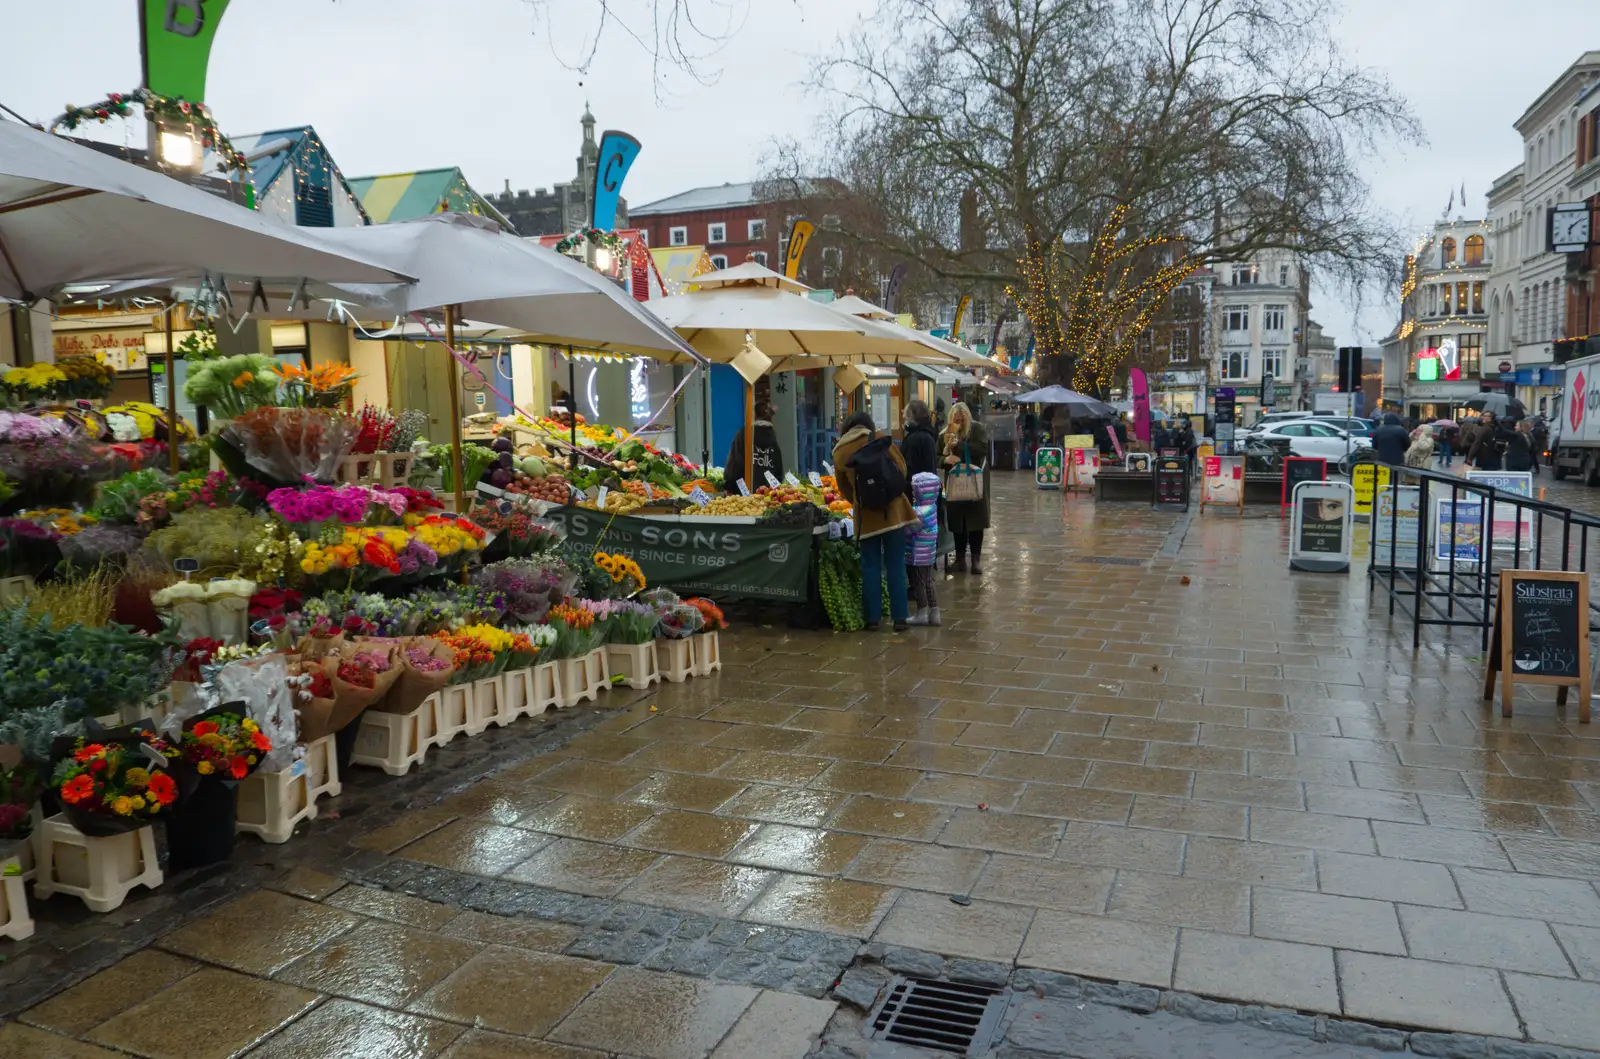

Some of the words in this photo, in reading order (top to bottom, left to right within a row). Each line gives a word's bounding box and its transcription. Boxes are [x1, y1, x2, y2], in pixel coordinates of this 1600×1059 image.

[603, 152, 624, 193] C
[596, 528, 633, 542] AND
[641, 526, 742, 552] SONS
[639, 549, 685, 564] SINCE
[692, 554, 726, 567] 1968
[1516, 583, 1573, 599] Substrata
